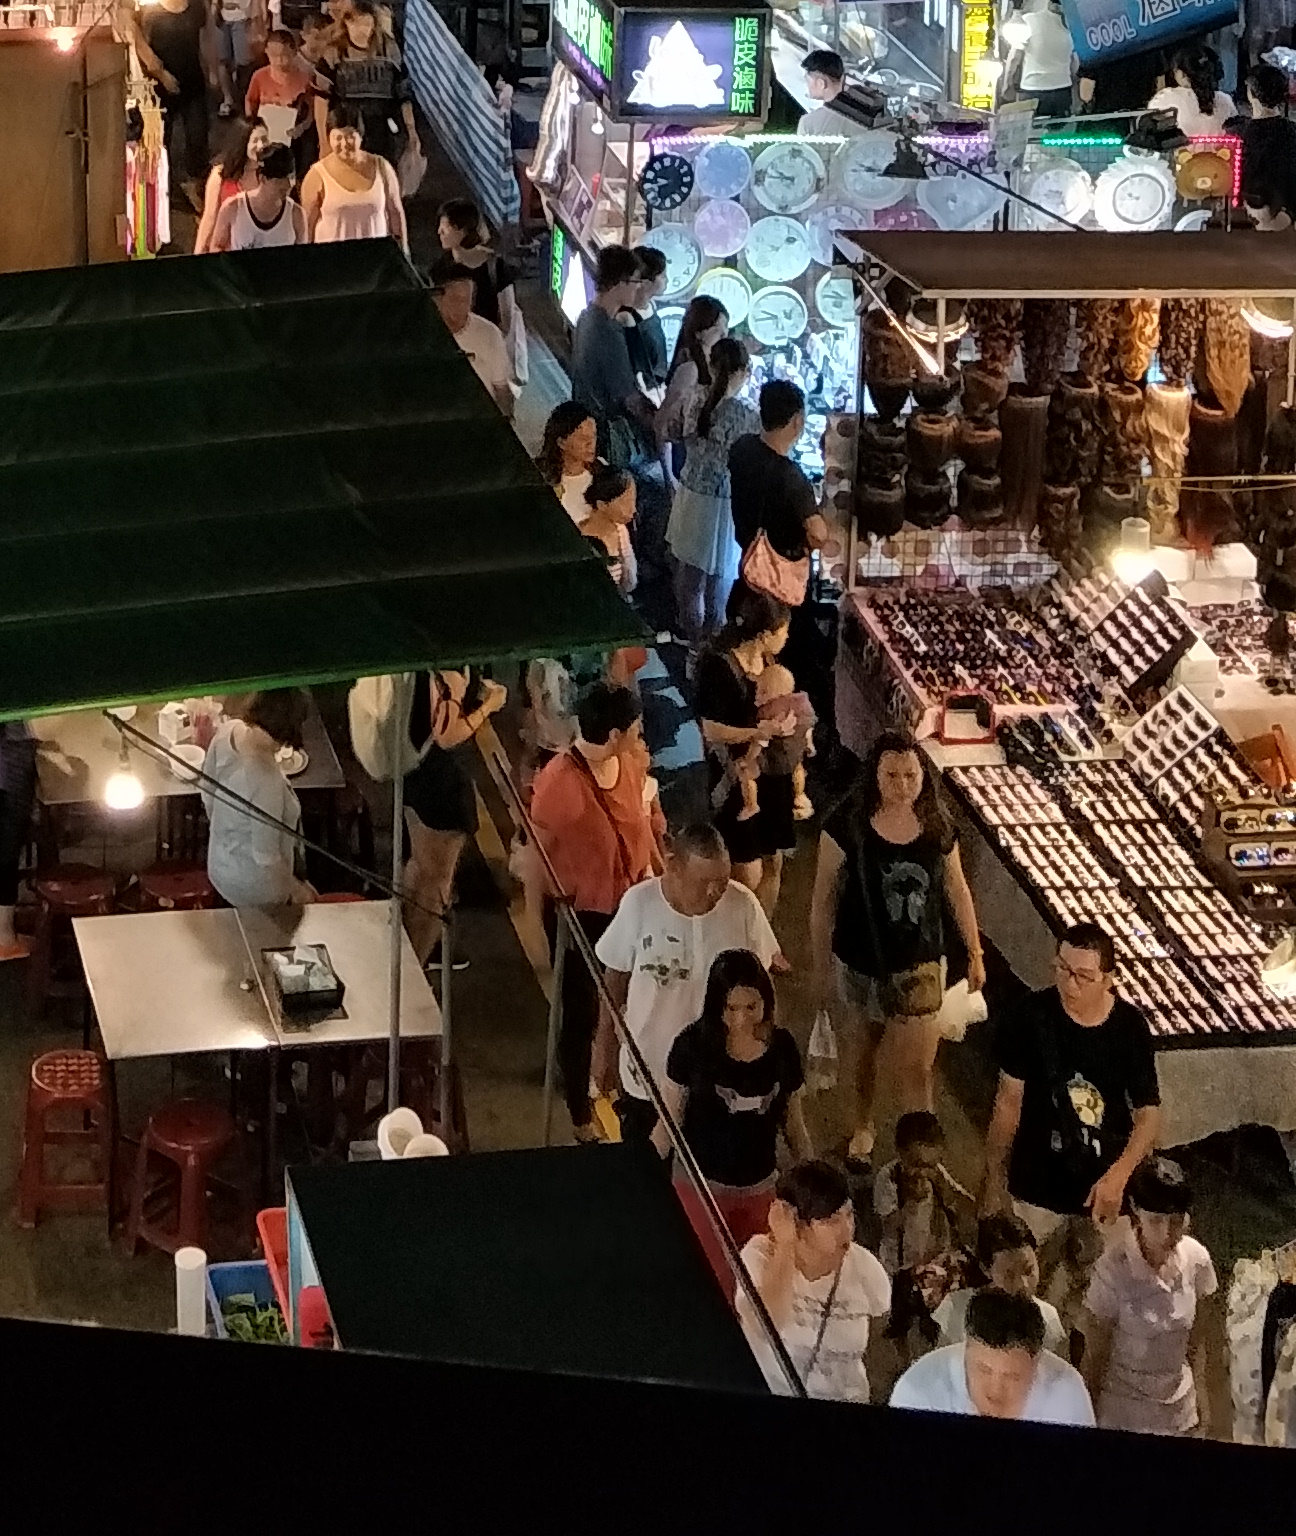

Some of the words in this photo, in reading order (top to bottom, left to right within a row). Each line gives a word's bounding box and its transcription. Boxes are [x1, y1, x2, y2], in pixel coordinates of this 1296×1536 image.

[730, 16, 759, 114] 脆皮滷味
[1085, 15, 1137, 52] COOL
